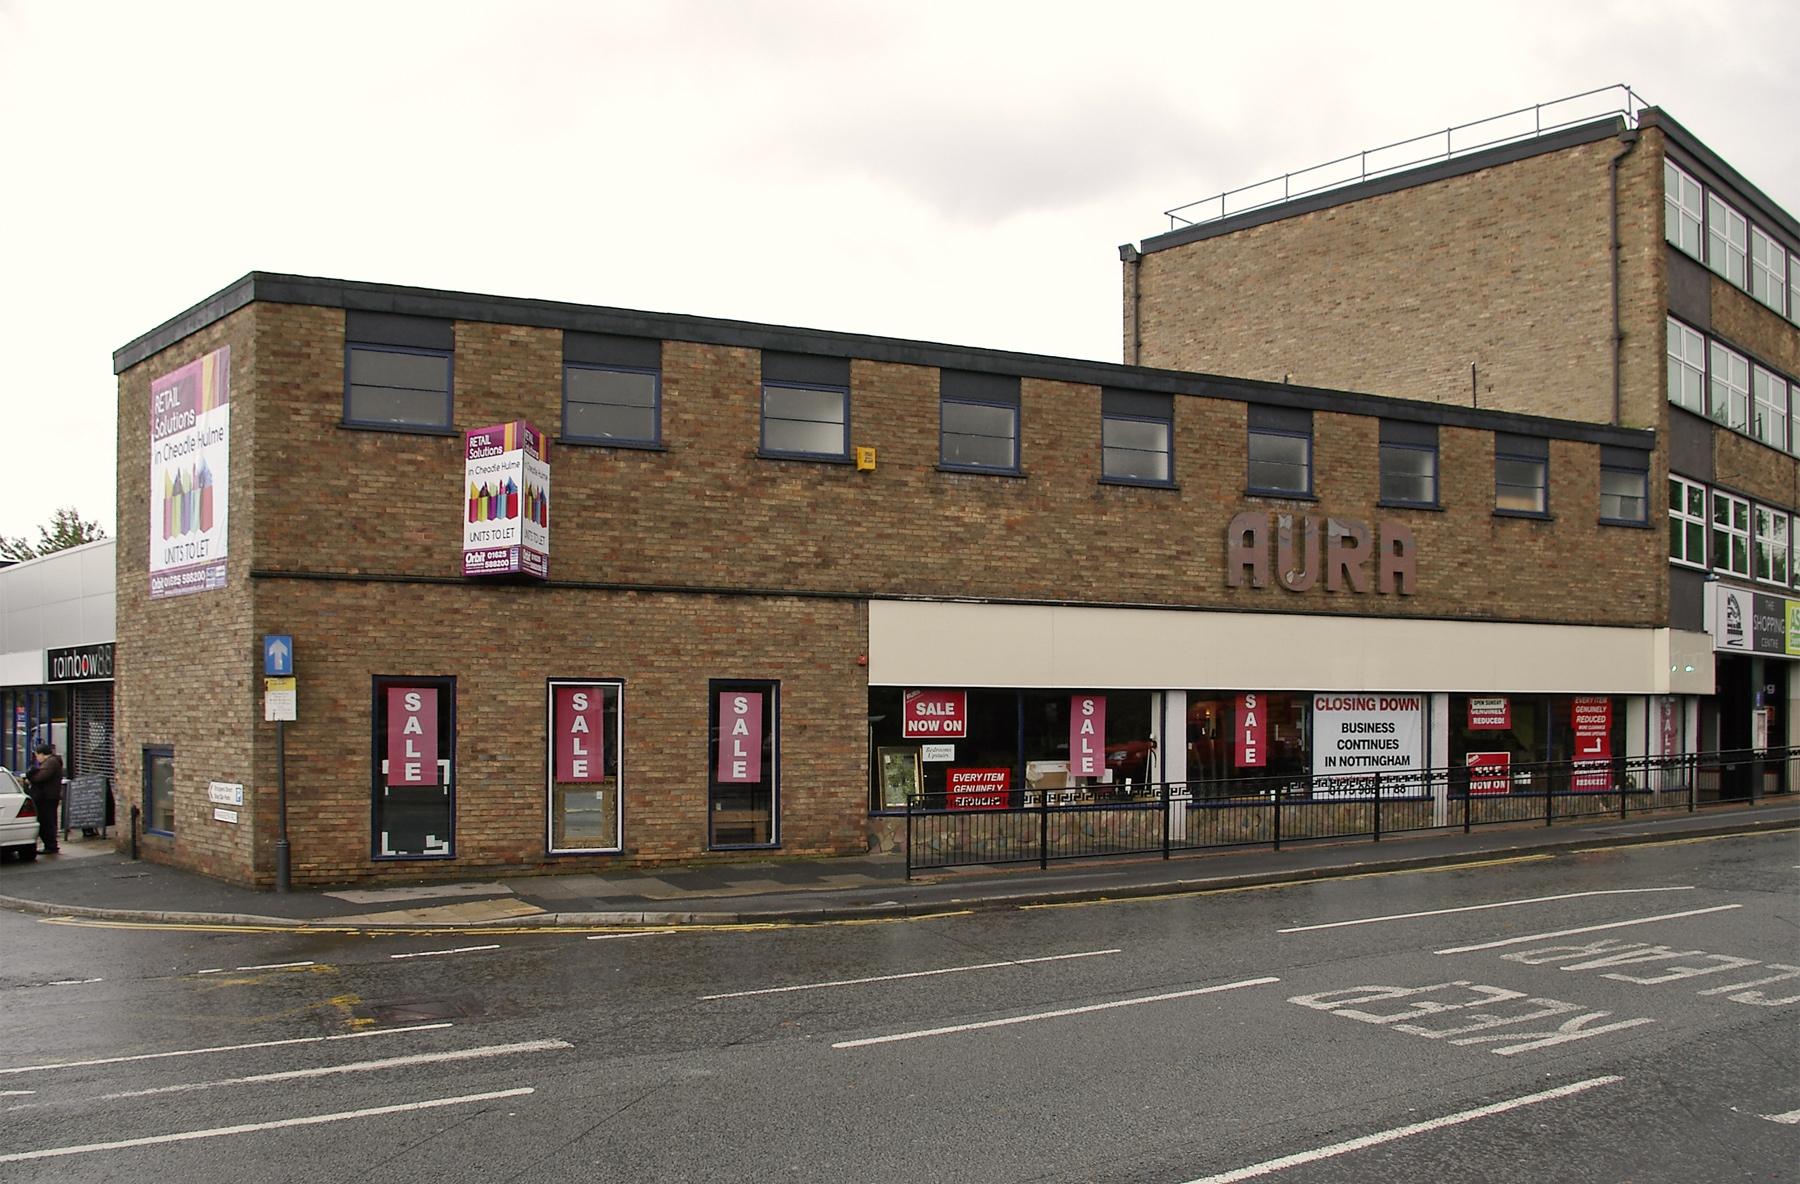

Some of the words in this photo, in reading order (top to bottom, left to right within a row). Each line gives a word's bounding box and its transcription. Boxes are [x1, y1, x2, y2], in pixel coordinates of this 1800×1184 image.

[154, 388, 181, 414] RETAIL
[153, 408, 195, 439] Solutions
[163, 437, 195, 461] Cheadle
[197, 426, 224, 452] Hulme
[469, 434, 491, 447] RETAIL
[469, 445, 503, 459] Solutions
[475, 464, 500, 475] Cheadle
[501, 460, 520, 472] Hulme
[470, 530, 490, 542] UNITS
[491, 529, 501, 541] TO
[502, 528, 515, 539] LET
[164, 544, 186, 564] UNITS
[196, 539, 210, 559] LET
[465, 552, 485, 563] Orbit
[1226, 511, 1417, 594] AURA
[1753, 613, 1785, 634] SHOPPING
[916, 702, 955, 716] SALE
[1315, 697, 1376, 711] CLOSING
[1379, 697, 1419, 711] DOWN
[1575, 705, 1607, 713] GENUINELY
[908, 720, 940, 732] NOW
[943, 720, 962, 732] ON
[1244, 694, 1257, 763] SALE
[1341, 722, 1395, 733] BUSINESS
[404, 692, 422, 781] SALE
[572, 692, 589, 778] SALE
[732, 697, 749, 778] SALE
[1080, 700, 1095, 773] SALE
[1337, 739, 1399, 750] CONTINUES
[1325, 756, 1336, 767] IN
[1339, 755, 1410, 767] NOTTINGHAM
[953, 773, 983, 783] EVERY
[983, 773, 1005, 782] ITEM
[1469, 781, 1492, 790] NOW
[1493, 780, 1506, 789] ON
[1288, 980, 1656, 1055] KEEP
